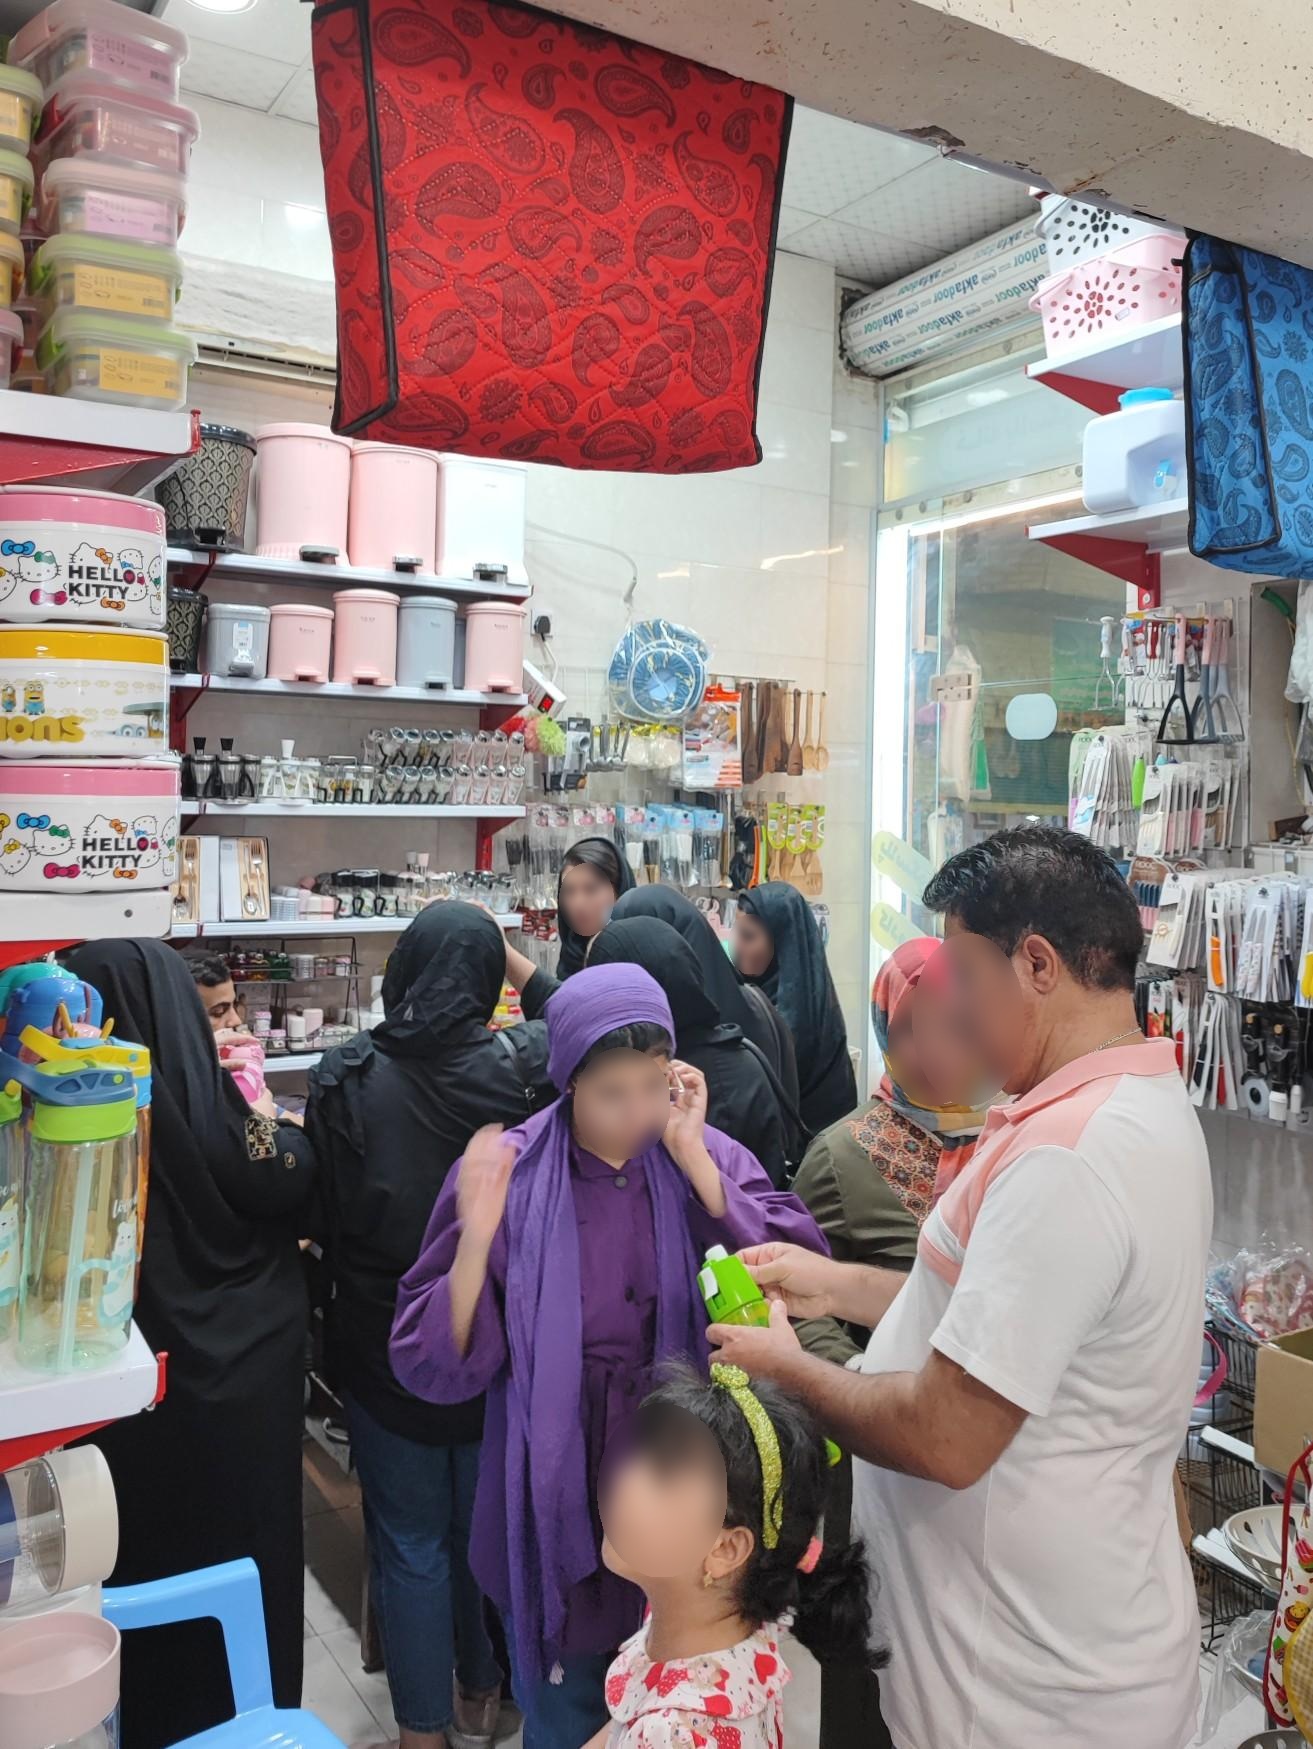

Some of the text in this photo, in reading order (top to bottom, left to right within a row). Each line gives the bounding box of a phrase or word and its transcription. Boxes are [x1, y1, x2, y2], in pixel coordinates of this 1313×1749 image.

[1013, 243, 1047, 268] adoor
[933, 273, 979, 303] akfadoor
[863, 308, 904, 334] akfadoor
[917, 310, 964, 335] akfadoor
[68, 564, 136, 585] HELLO
[68, 582, 130, 600] KITTY
[0, 715, 86, 743] ions
[82, 836, 149, 852] HELLO
[82, 854, 142, 869] KITTY
